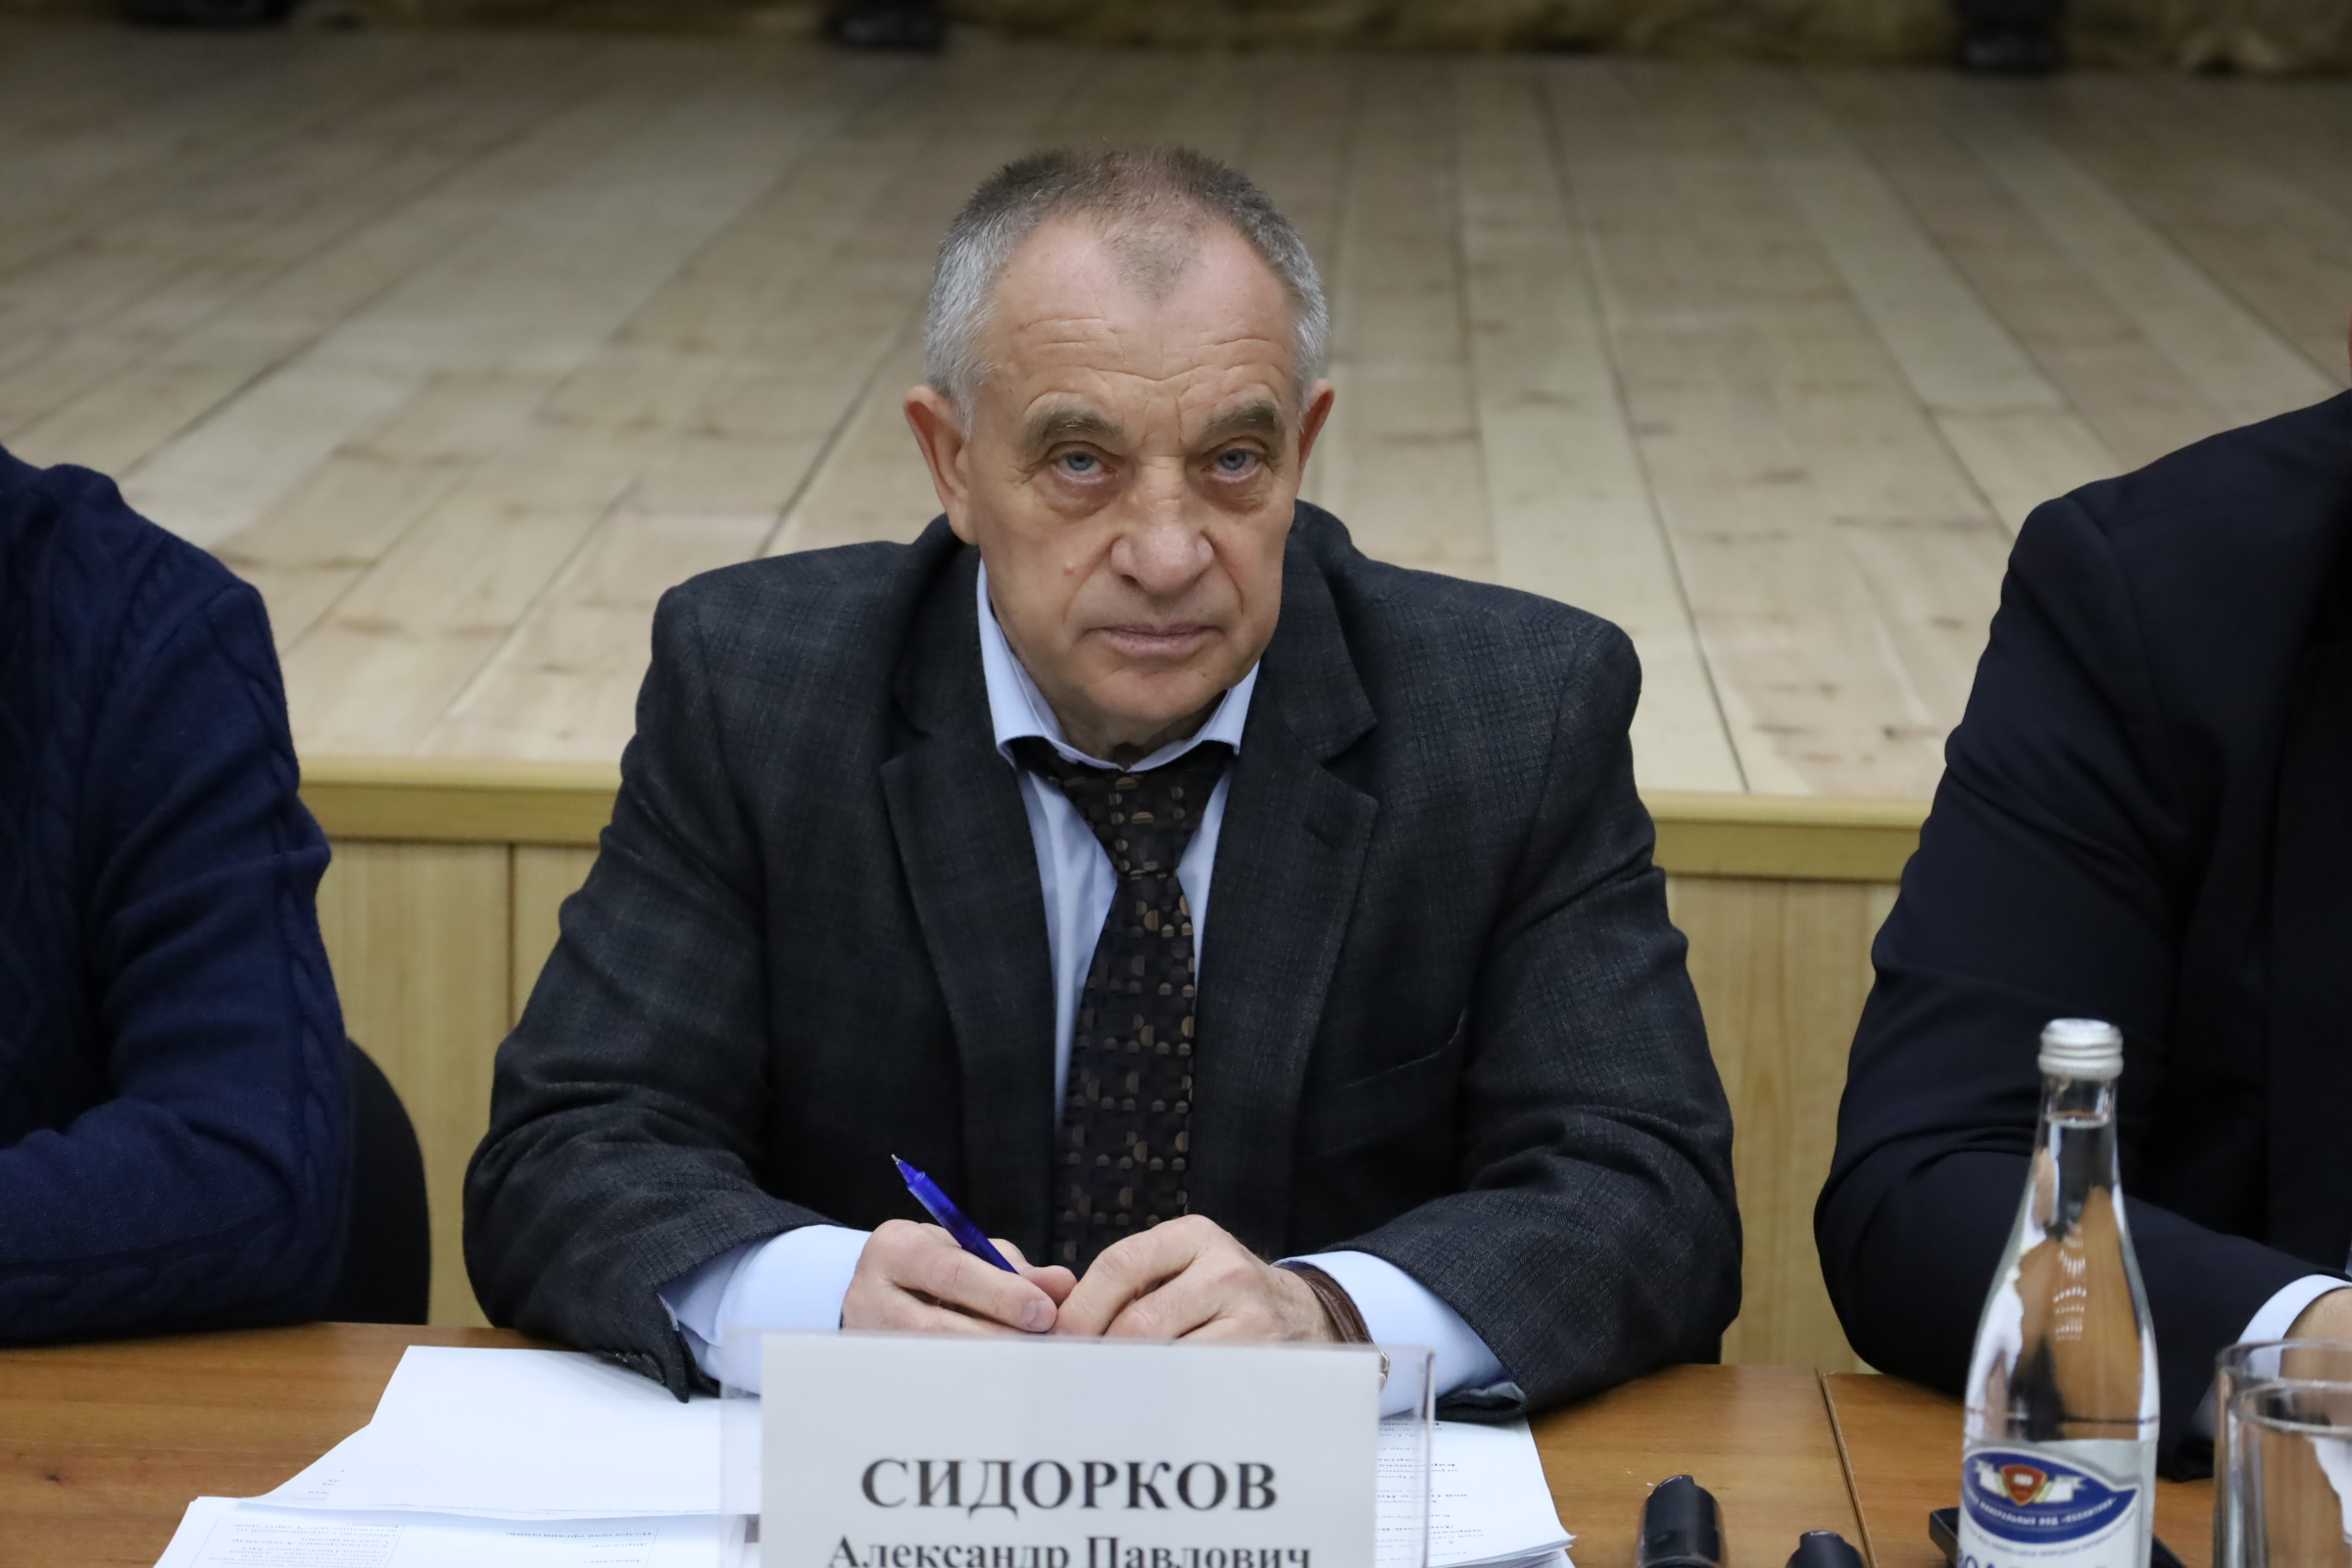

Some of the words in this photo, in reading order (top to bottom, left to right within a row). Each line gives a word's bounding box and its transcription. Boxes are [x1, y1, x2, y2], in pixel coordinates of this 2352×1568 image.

[860, 1457, 1278, 1520] СИДОРКОВ
[828, 1534, 1071, 1568] Александр
[1086, 1535, 1311, 1568] Павлович
